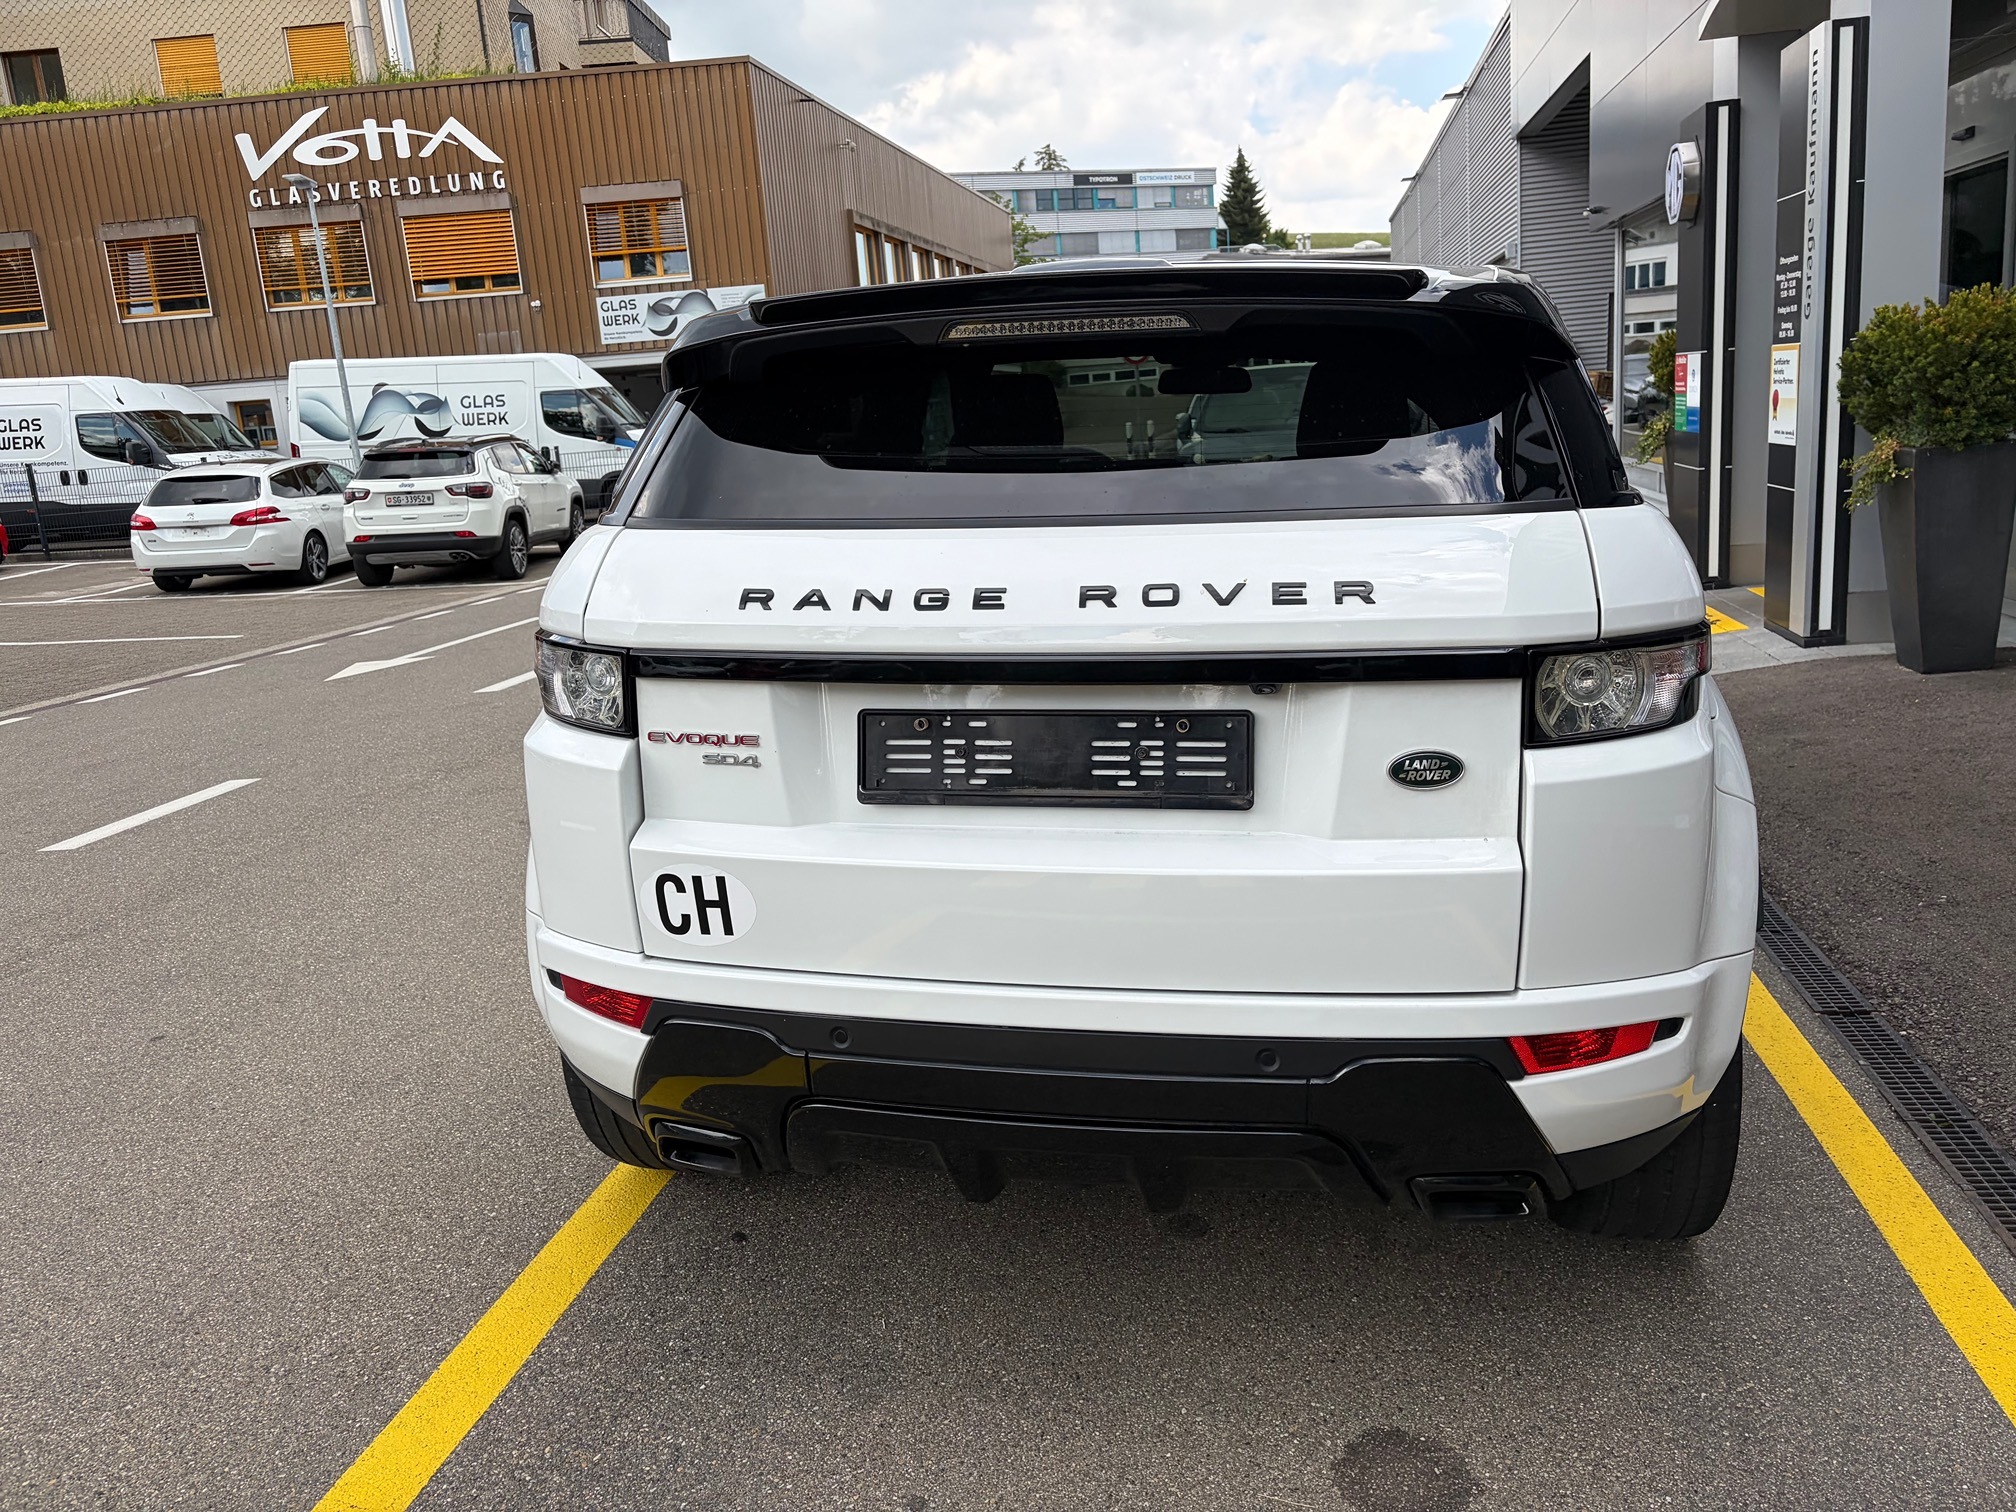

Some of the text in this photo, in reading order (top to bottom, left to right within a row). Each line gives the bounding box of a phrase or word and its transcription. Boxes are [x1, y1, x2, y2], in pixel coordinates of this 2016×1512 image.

[249, 170, 506, 208] GLASVEREDLUNG
[1804, 48, 1818, 320] Garage Kaufmann
[600, 299, 637, 312] GLAS
[602, 313, 640, 327] WERK
[460, 394, 506, 409] GLAS
[461, 411, 509, 426] WERK
[0, 436, 46, 450] WERK
[738, 580, 1377, 612] RANGE ROVER
[647, 731, 760, 748] EVOQUE
[702, 753, 762, 768] SD4
[1403, 759, 1440, 770] LAND
[1406, 769, 1452, 781] ROVER
[655, 873, 734, 936] CH
